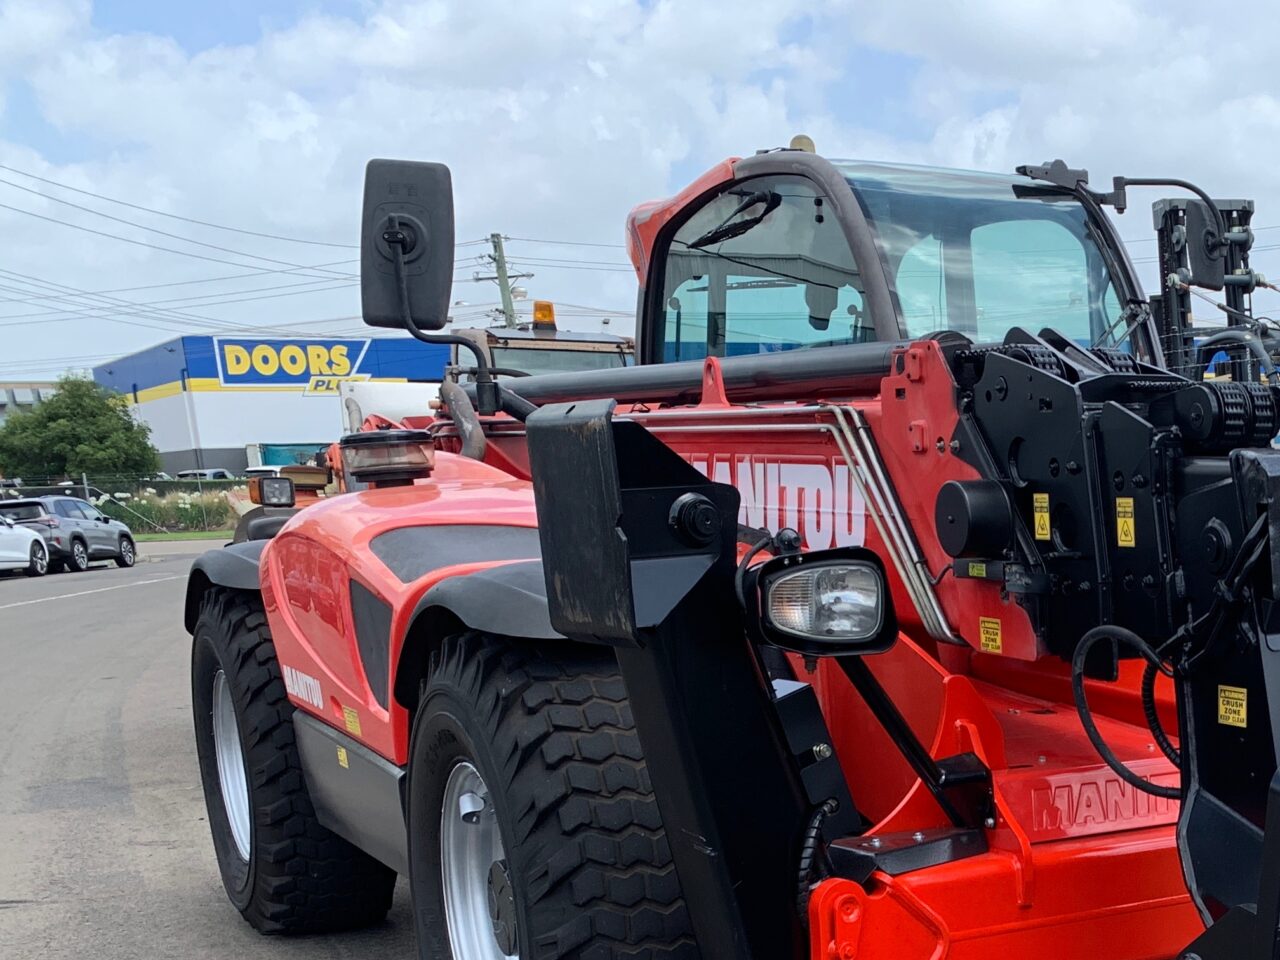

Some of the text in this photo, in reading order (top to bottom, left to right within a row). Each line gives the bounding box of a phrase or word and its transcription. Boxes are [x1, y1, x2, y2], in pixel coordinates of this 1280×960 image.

[224, 344, 351, 376] DOORS
[1221, 699, 1244, 709] CRUSH
[1224, 707, 1242, 716] ZONE
[1032, 773, 1181, 831] MANIT
